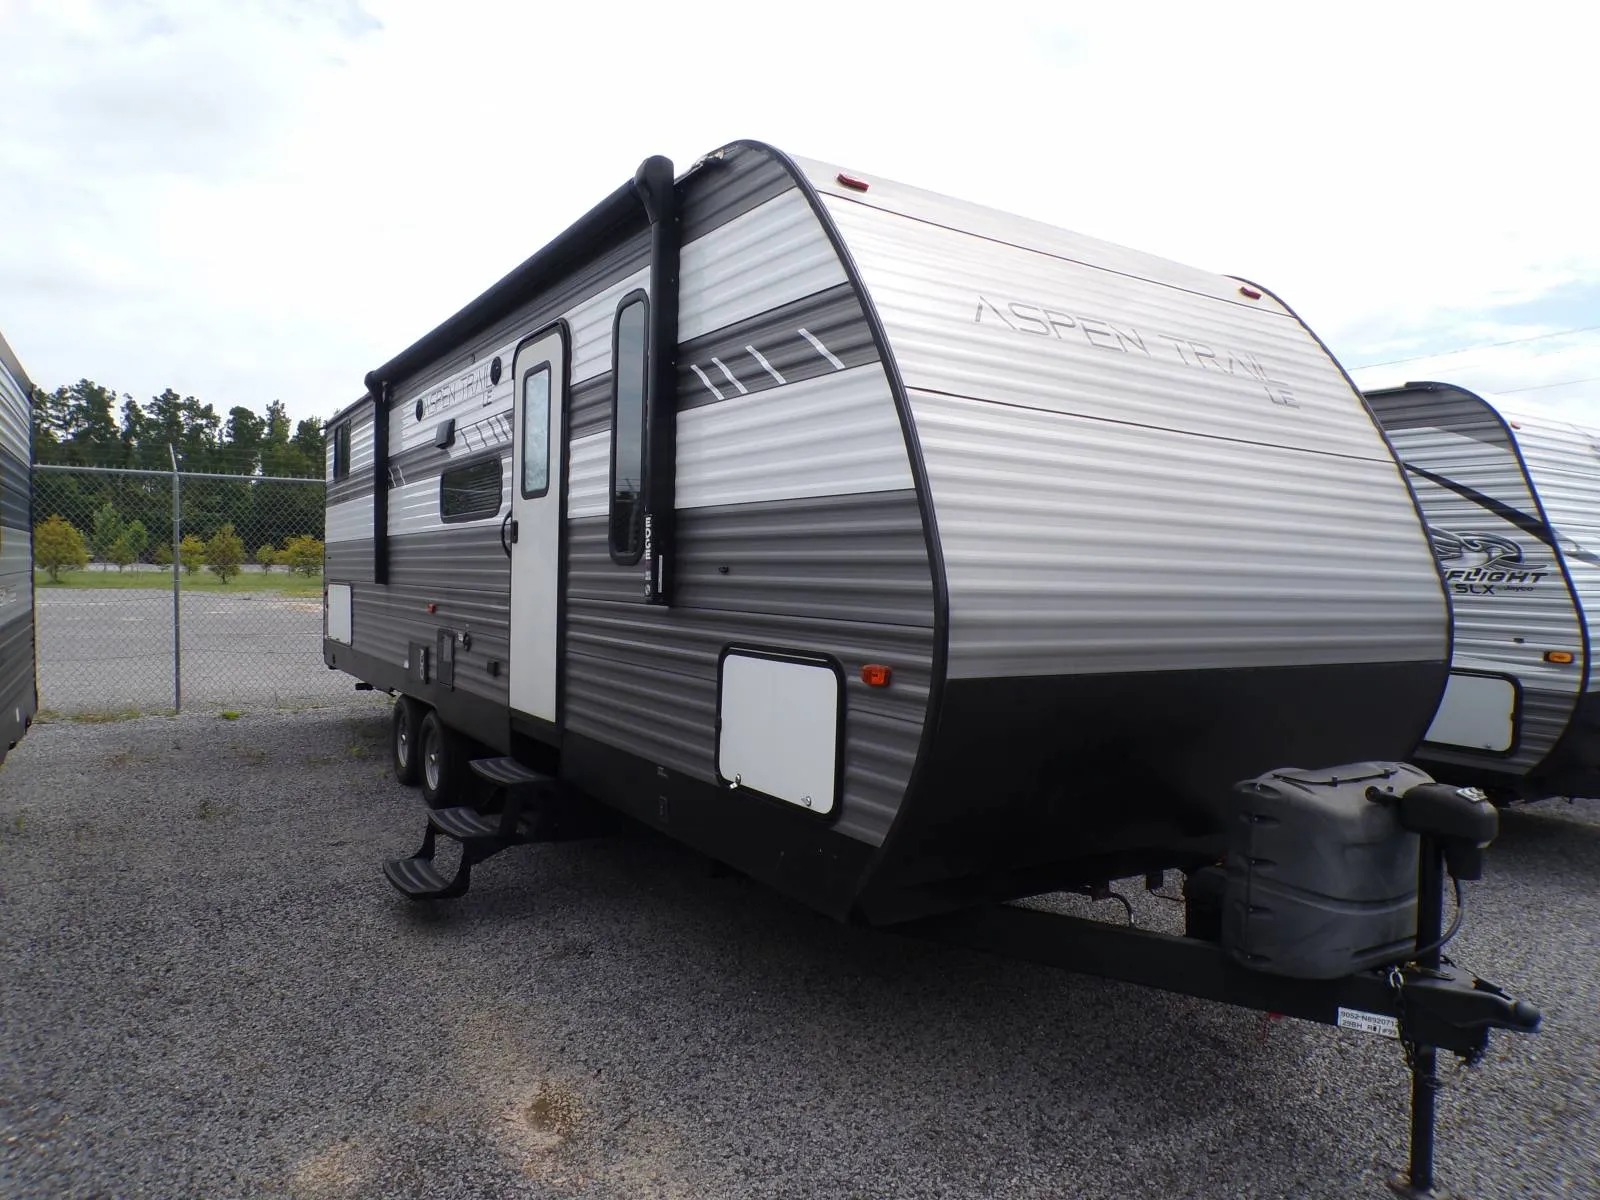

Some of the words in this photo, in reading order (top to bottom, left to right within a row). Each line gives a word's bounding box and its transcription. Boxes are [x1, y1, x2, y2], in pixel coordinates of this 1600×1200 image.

[974, 295, 1152, 358] ASPEN
[1157, 333, 1289, 387] TRAIL
[1455, 583, 1495, 595] SLX
